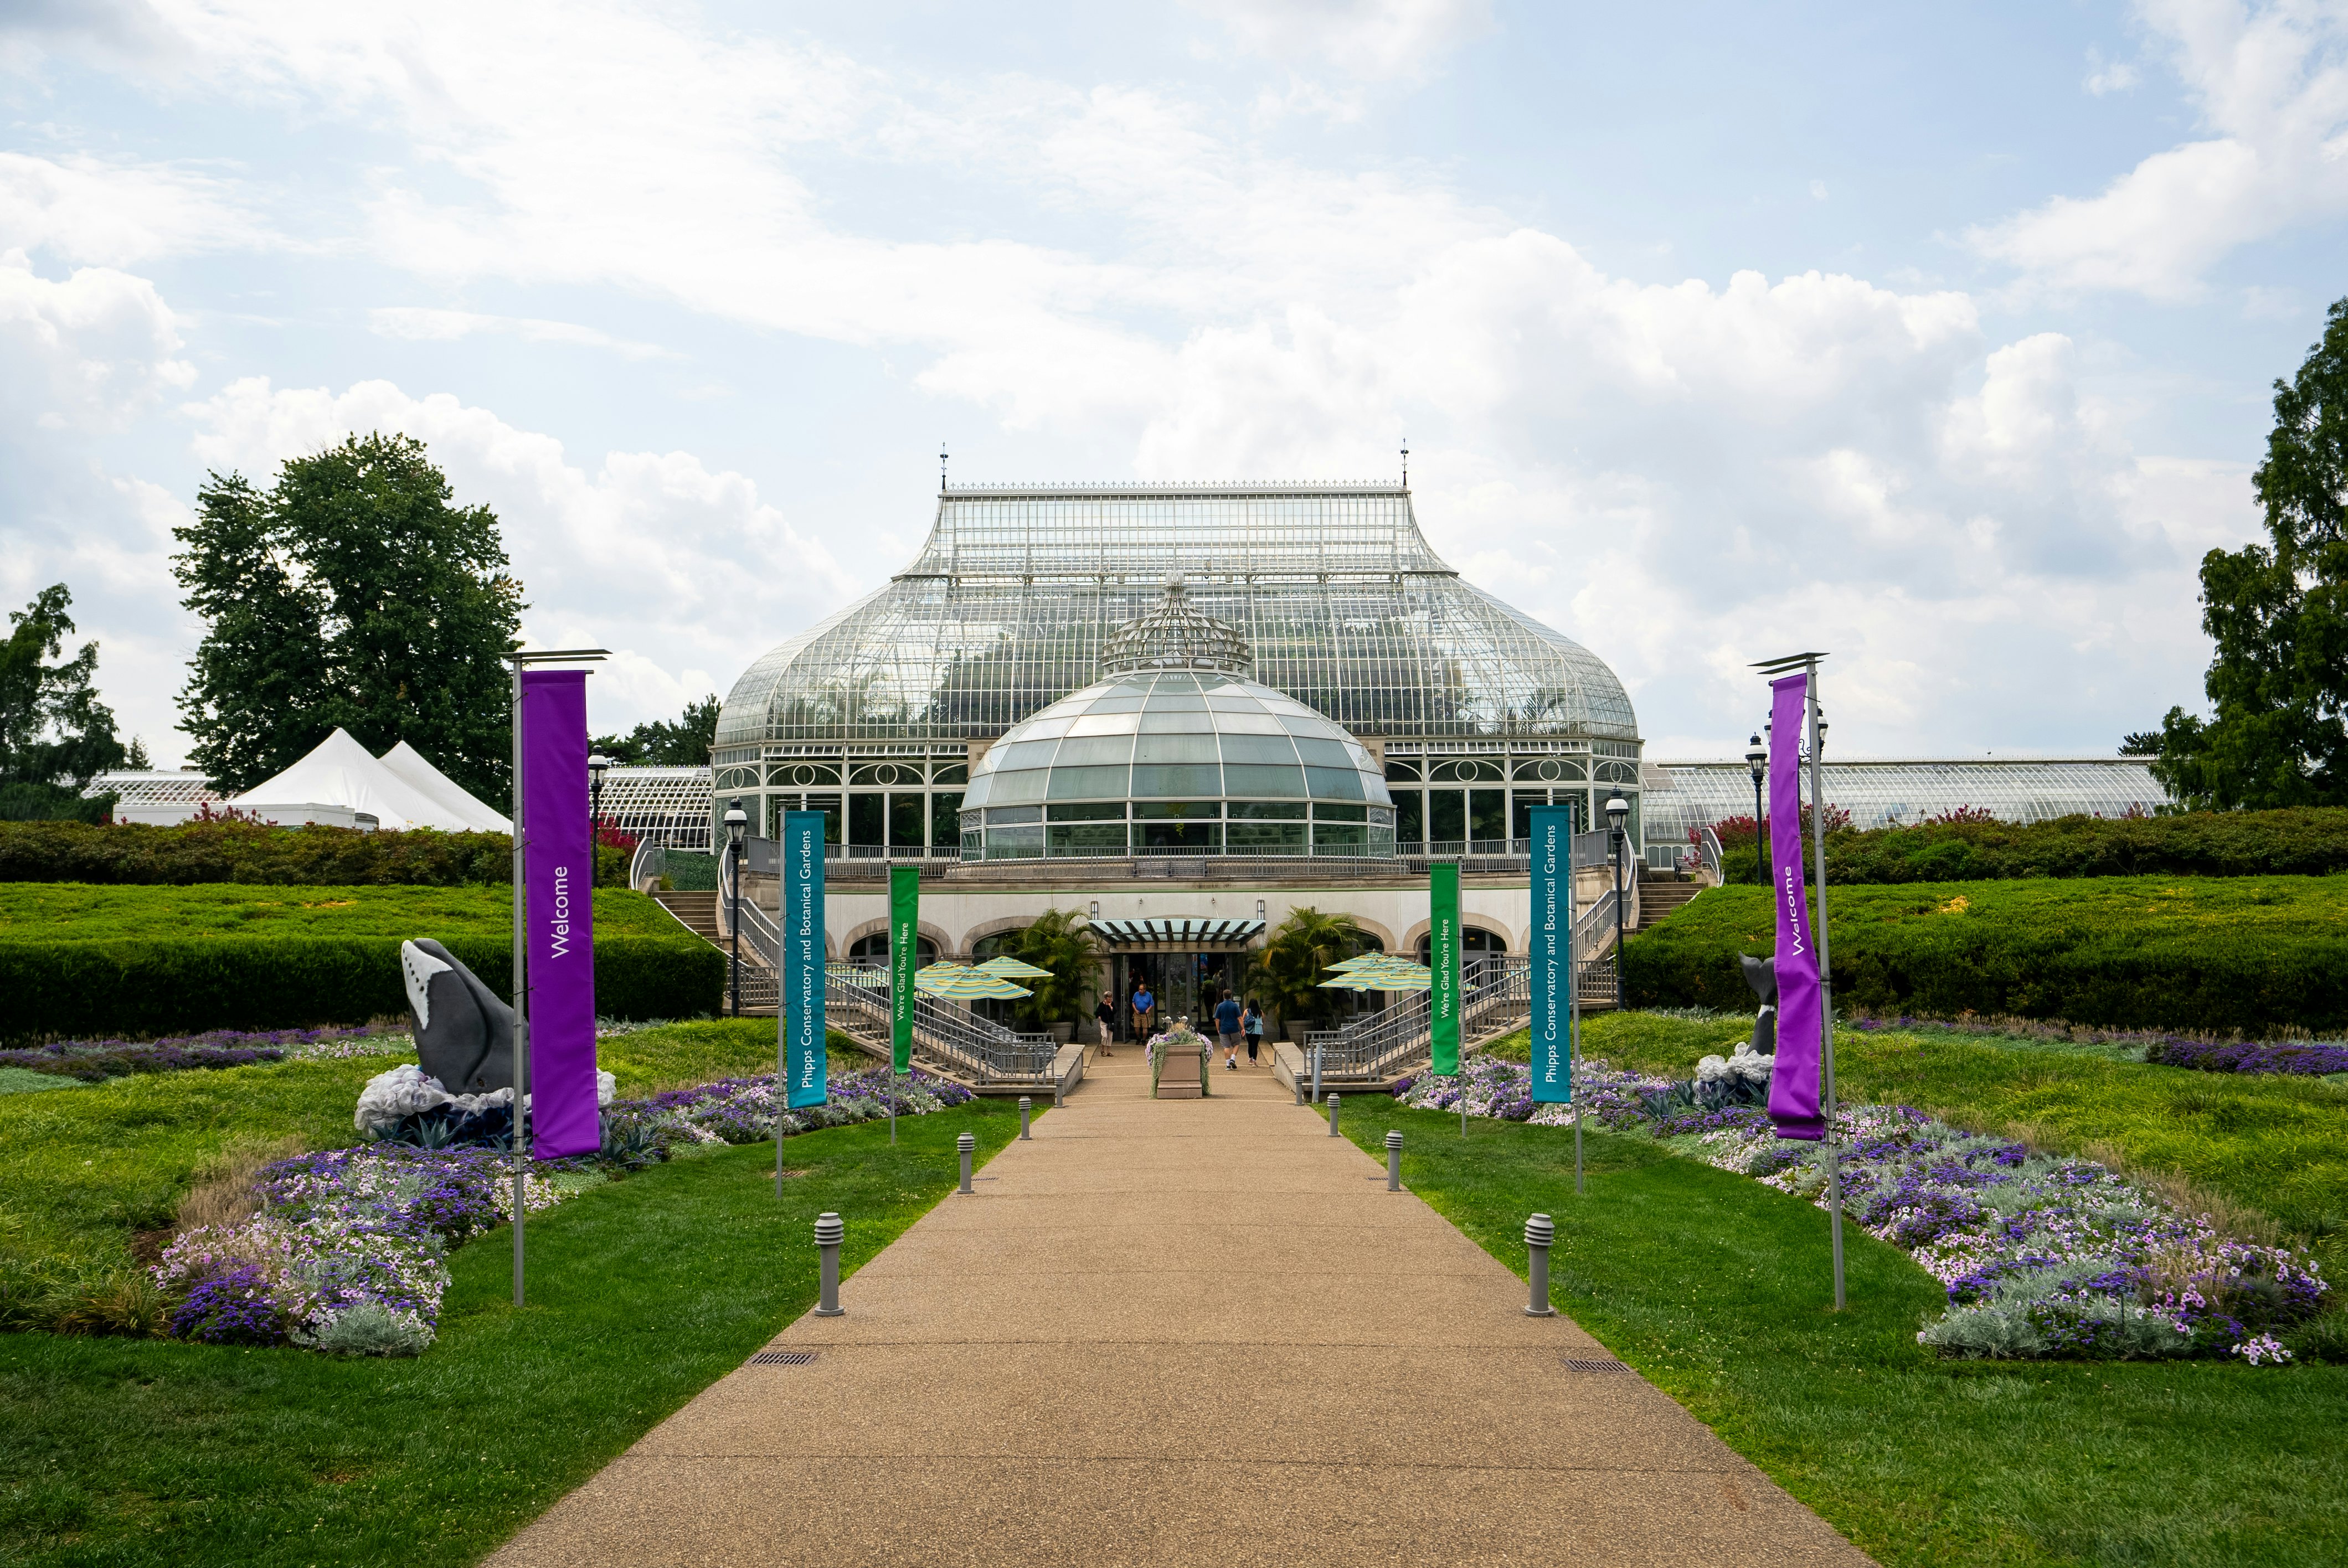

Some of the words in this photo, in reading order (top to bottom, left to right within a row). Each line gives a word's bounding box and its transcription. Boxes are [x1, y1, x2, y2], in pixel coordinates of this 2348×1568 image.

[799, 831, 811, 879] Gardens
[1543, 825, 1556, 874] Gardens
[550, 866, 570, 959] Welcome
[799, 884, 812, 936] Botanical
[1543, 878, 1556, 930] Botanical
[1784, 866, 1805, 956] Welcome
[899, 922, 909, 944] Here
[1440, 919, 1449, 941] Here
[1544, 935, 1556, 955] and
[799, 940, 812, 961] and
[897, 947, 908, 972] You're
[1440, 943, 1450, 970] You're
[897, 973, 906, 993] Glad
[1440, 970, 1450, 991] Glad
[800, 964, 815, 1046] Conservatory
[897, 995, 905, 1022] We're
[1440, 993, 1450, 1019] We're
[1544, 958, 1559, 1041] Conservatory
[801, 1050, 816, 1088] Phipps
[1544, 1045, 1561, 1082] Phipps
